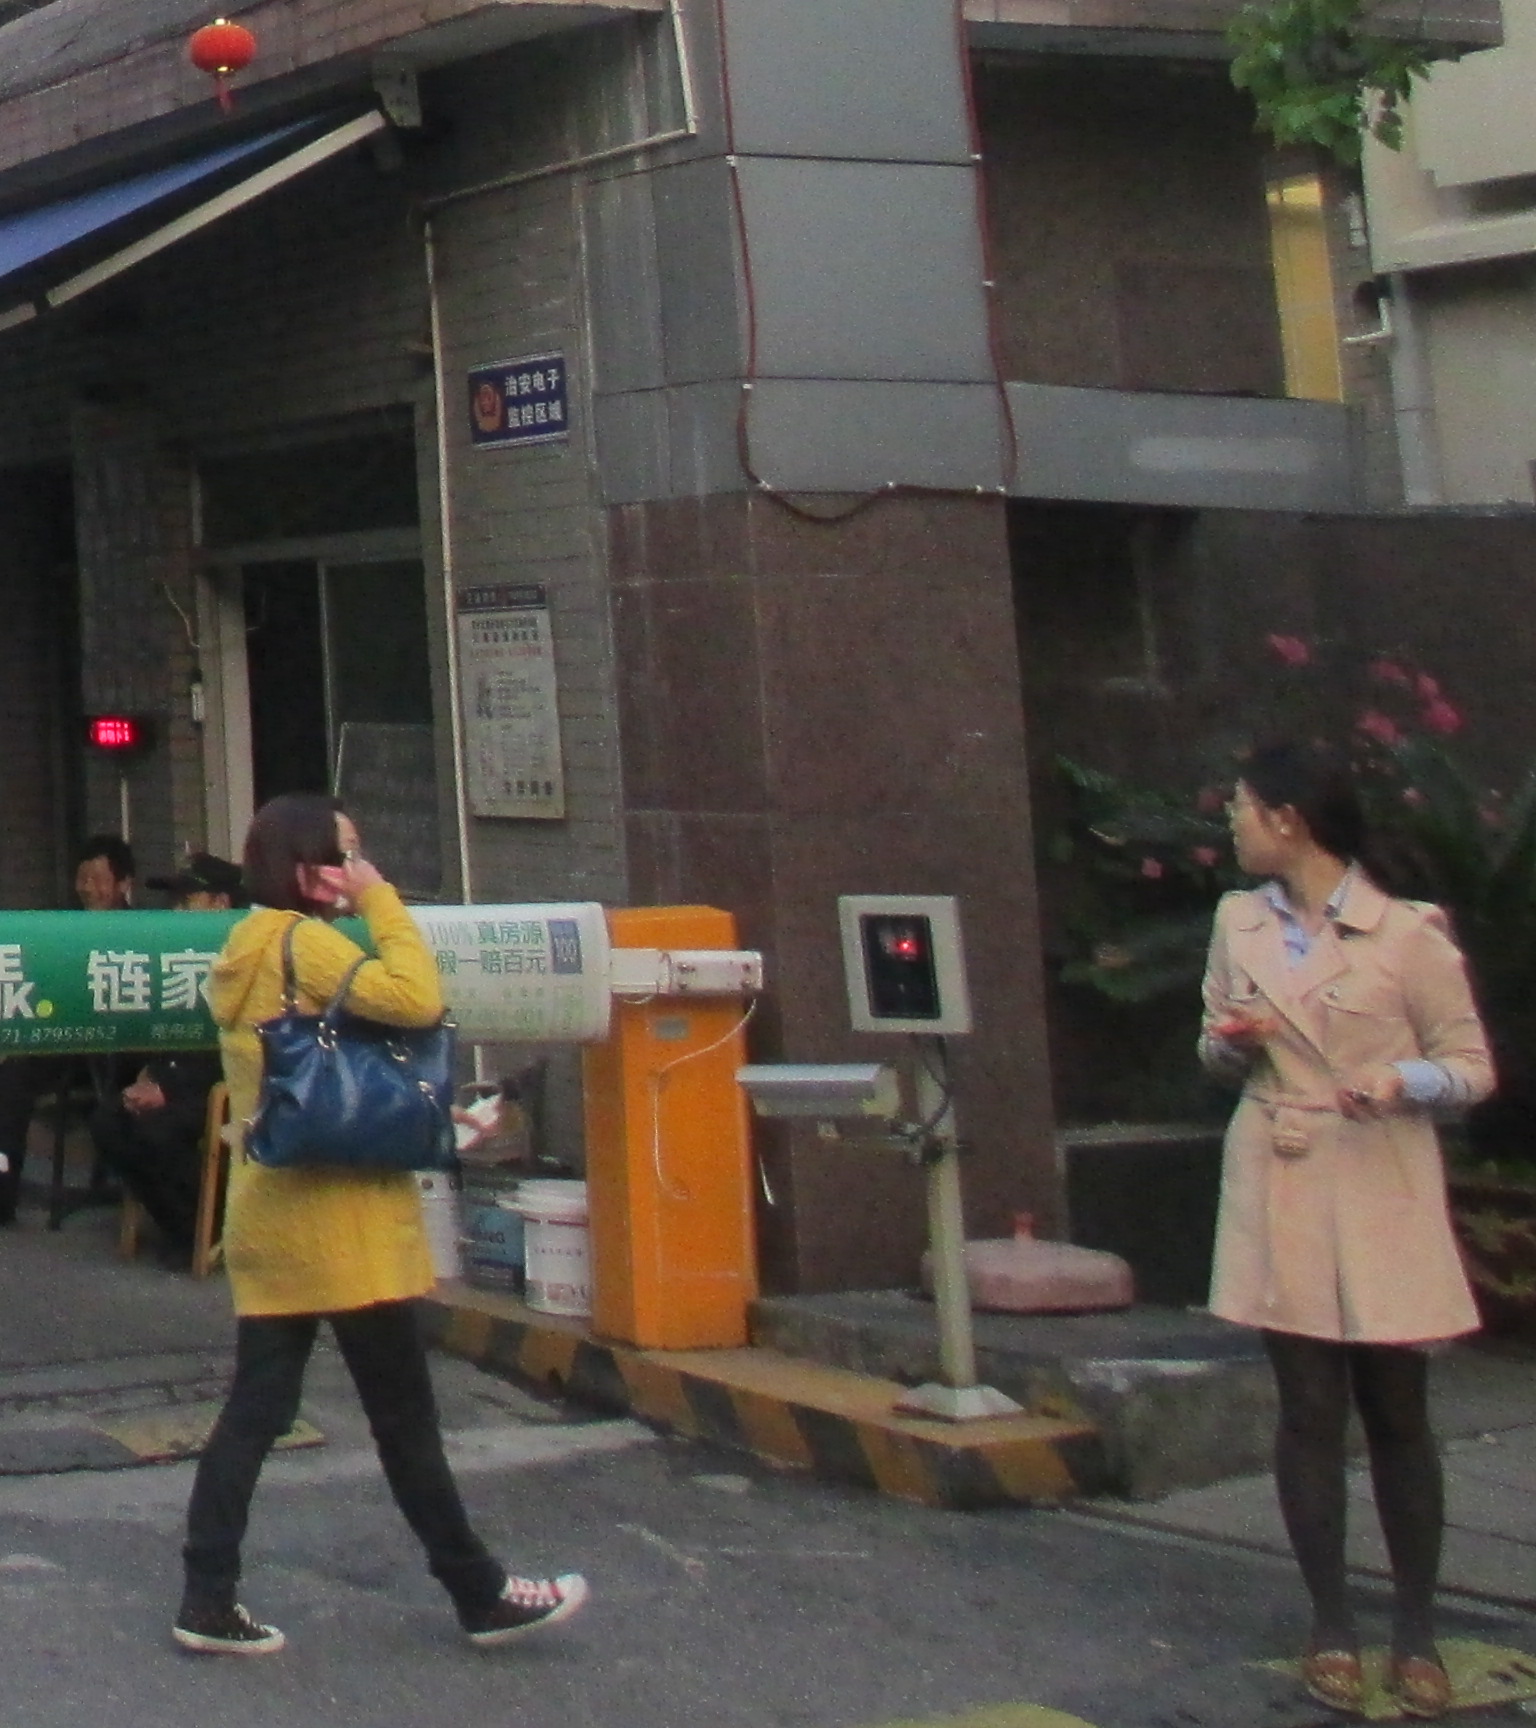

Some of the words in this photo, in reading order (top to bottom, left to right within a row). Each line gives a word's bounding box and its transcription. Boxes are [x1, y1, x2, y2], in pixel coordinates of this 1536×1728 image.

[504, 368, 561, 398] 治安电子
[507, 399, 563, 430] 监控区域
[477, 920, 545, 945] 真房源
[436, 949, 547, 975] 假一赔百元
